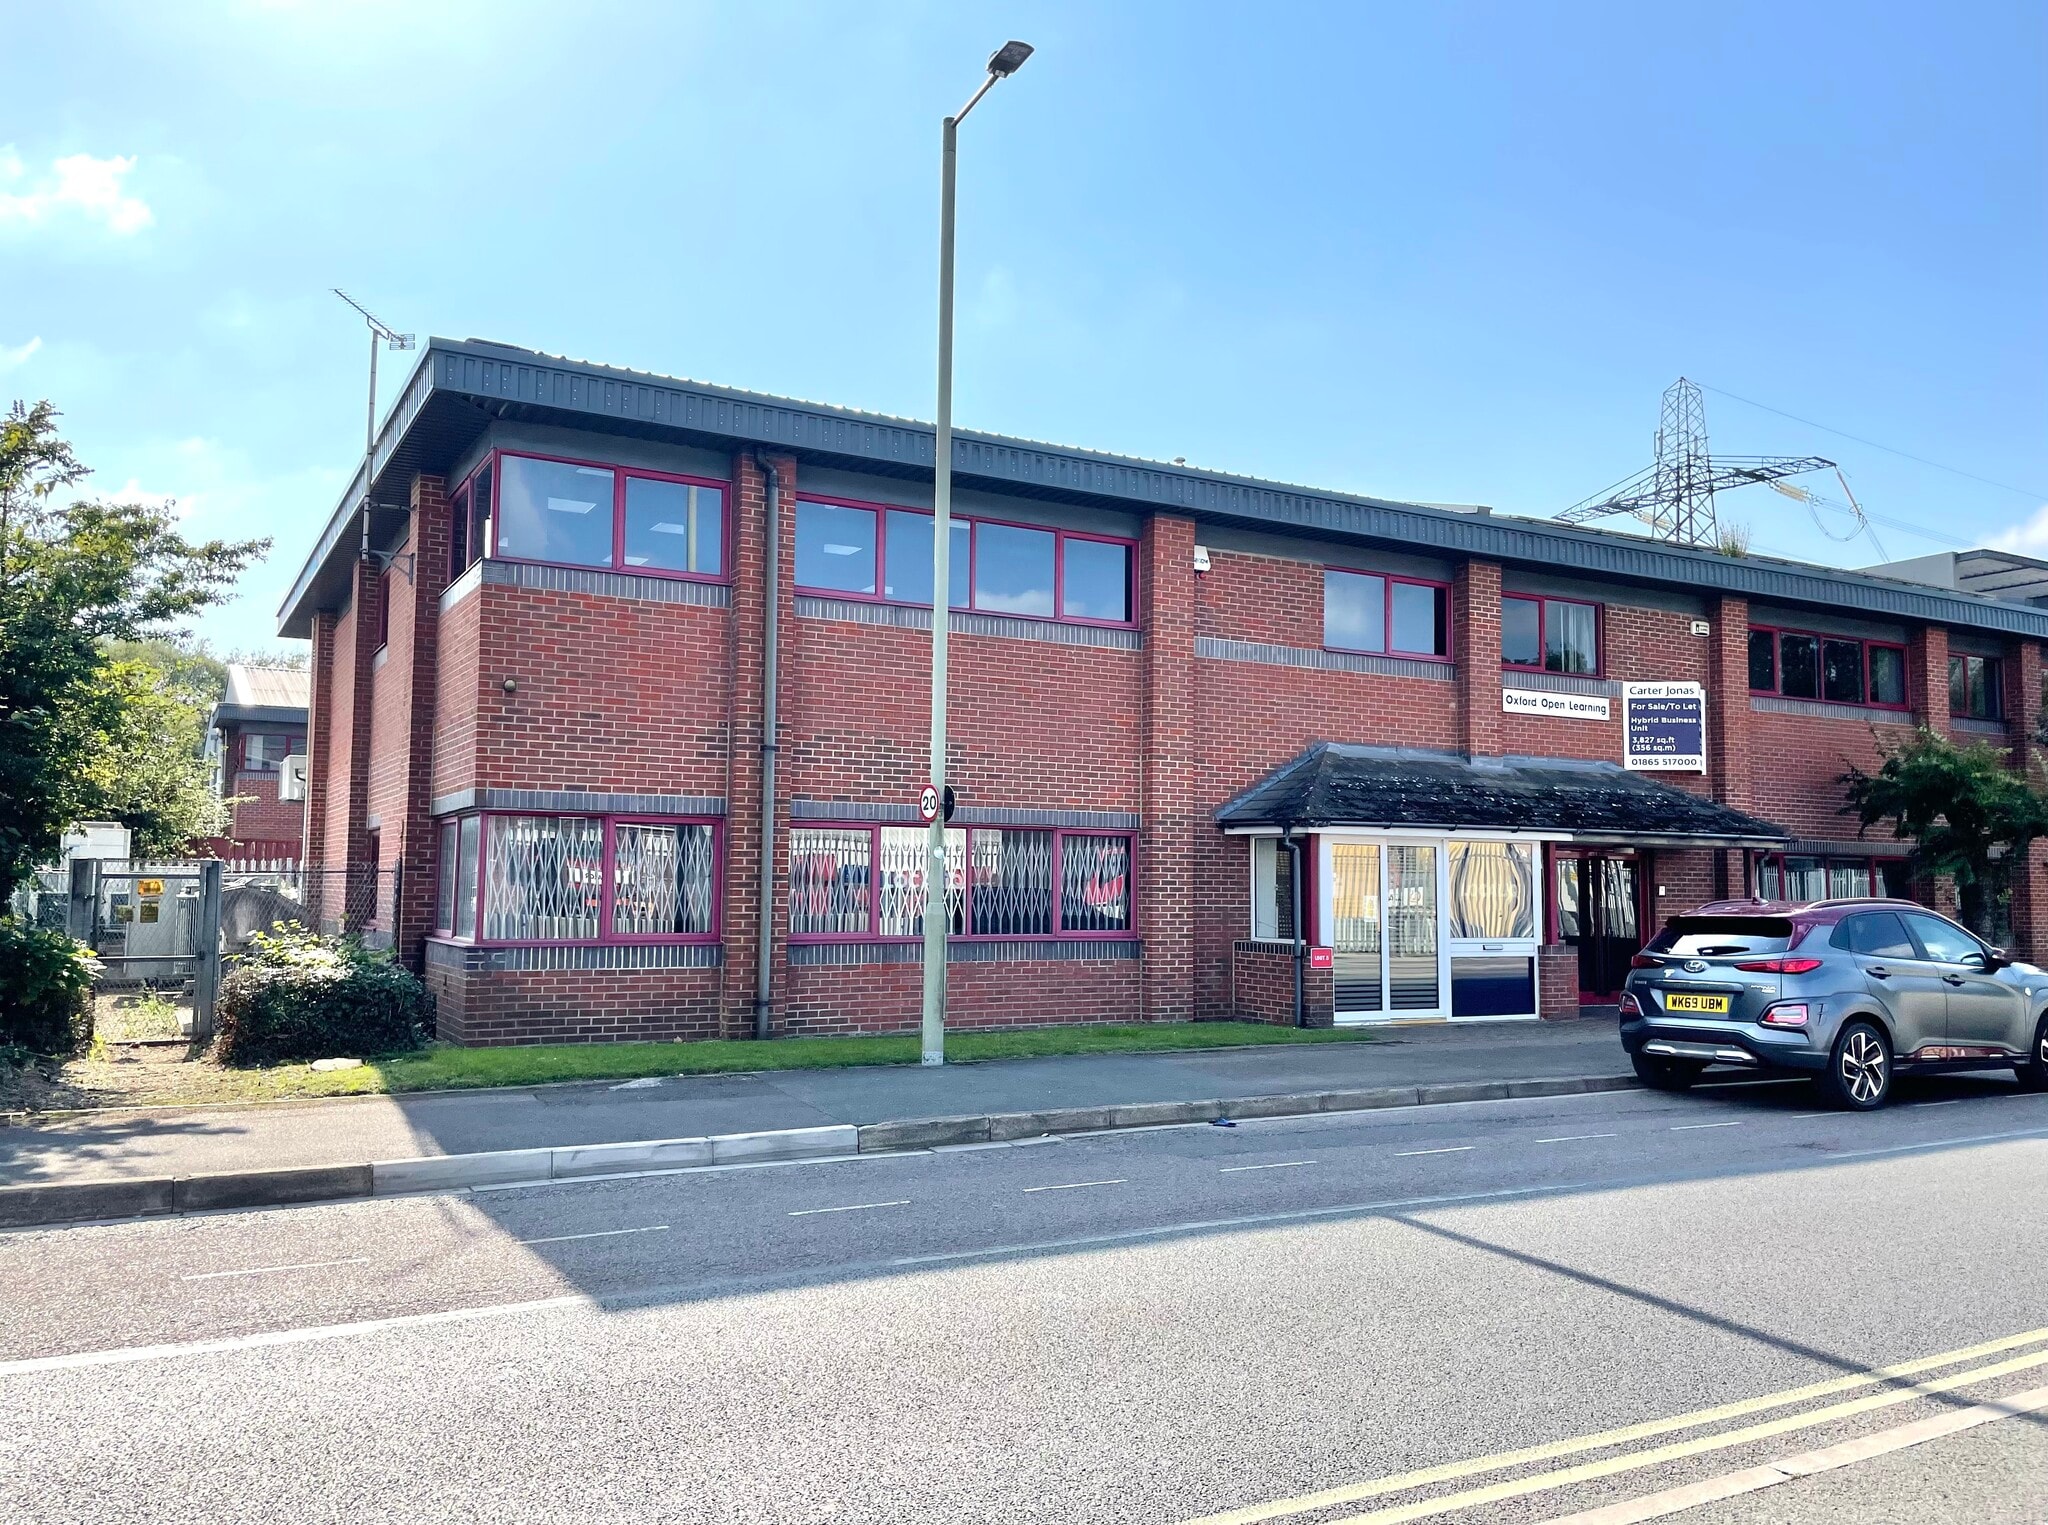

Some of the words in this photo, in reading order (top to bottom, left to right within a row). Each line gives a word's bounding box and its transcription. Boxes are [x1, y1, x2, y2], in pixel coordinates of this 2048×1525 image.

[1629, 686, 1662, 695] Carter
[1665, 686, 1695, 697] Jonas
[1505, 694, 1537, 707] Oxford
[1541, 698, 1565, 710] Open
[1569, 701, 1607, 715] Learning
[1647, 702, 1681, 711] Sale/To
[1631, 717, 1659, 725] Hybrid
[1632, 736, 1655, 744] 3,827
[1656, 736, 1675, 744] sq.ft
[1631, 744, 1651, 752] (356
[1653, 744, 1676, 752] sq.m)
[1631, 758, 1660, 766] 01865
[1662, 758, 1697, 766] 517000
[922, 795, 937, 811] 20
[1671, 996, 1698, 1008] WK69
[1701, 998, 1723, 1010] UBM
